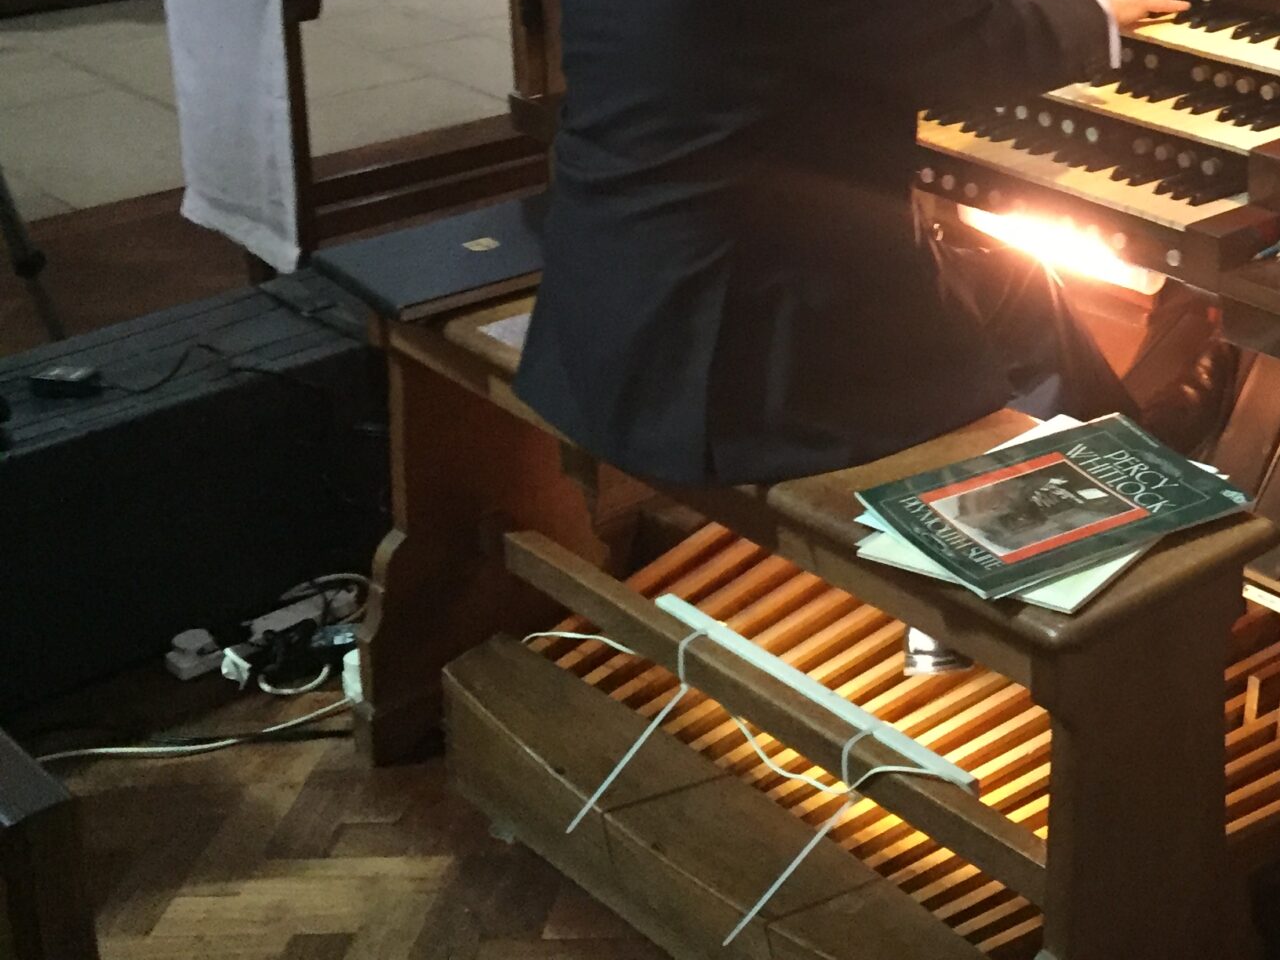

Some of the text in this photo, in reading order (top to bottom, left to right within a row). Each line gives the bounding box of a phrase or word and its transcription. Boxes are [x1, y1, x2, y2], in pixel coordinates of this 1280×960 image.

[1066, 443, 1176, 513] WHITLOCK
[1103, 449, 1179, 490] PERCY
[899, 496, 1002, 571] PLYMOUTH SUITE
